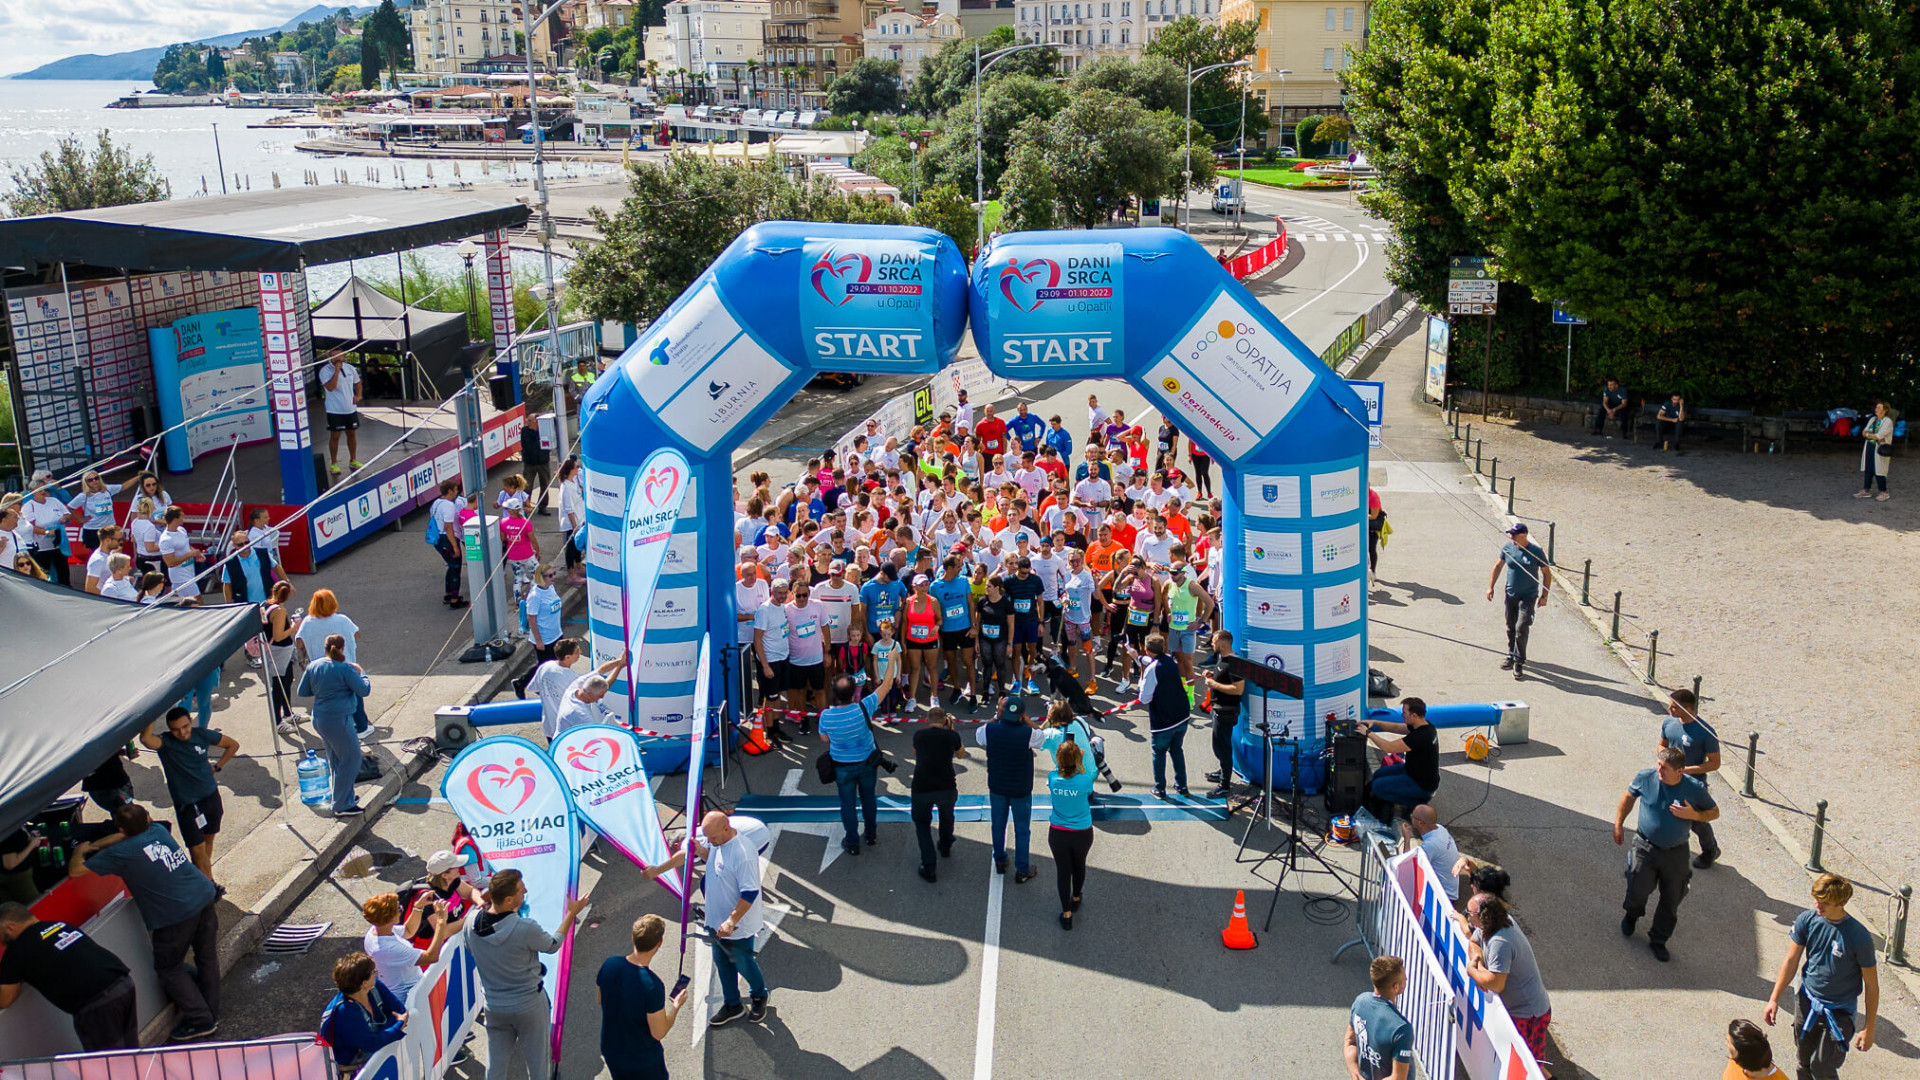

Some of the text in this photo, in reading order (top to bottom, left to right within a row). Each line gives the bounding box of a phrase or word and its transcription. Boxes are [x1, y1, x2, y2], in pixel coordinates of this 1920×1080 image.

[1223, 187, 1230, 196] P
[879, 253, 922, 266] DANI
[1067, 257, 1111, 269] DANI
[878, 267, 922, 281] SRCA
[1067, 271, 1112, 284] SRCA
[877, 298, 921, 311] u Opatiji
[1077, 302, 1112, 314] Opatiji
[181, 321, 202, 336] DANI
[183, 333, 204, 348] SRCA
[813, 331, 922, 358] START
[1003, 337, 1112, 363] START
[1236, 338, 1292, 396] OPATIJA
[709, 381, 757, 423] LIBURNIA
[1182, 391, 1236, 441] Dezinsekcija
[507, 422, 522, 441] AVIS
[417, 467, 434, 489] HEP
[629, 515, 654, 530] DANI
[951, 607, 960, 616] 60
[655, 659, 693, 667] NOVARTIS
[571, 779, 606, 797] DANI
[606, 764, 644, 783] SRCA
[1053, 787, 1079, 797] CREW
